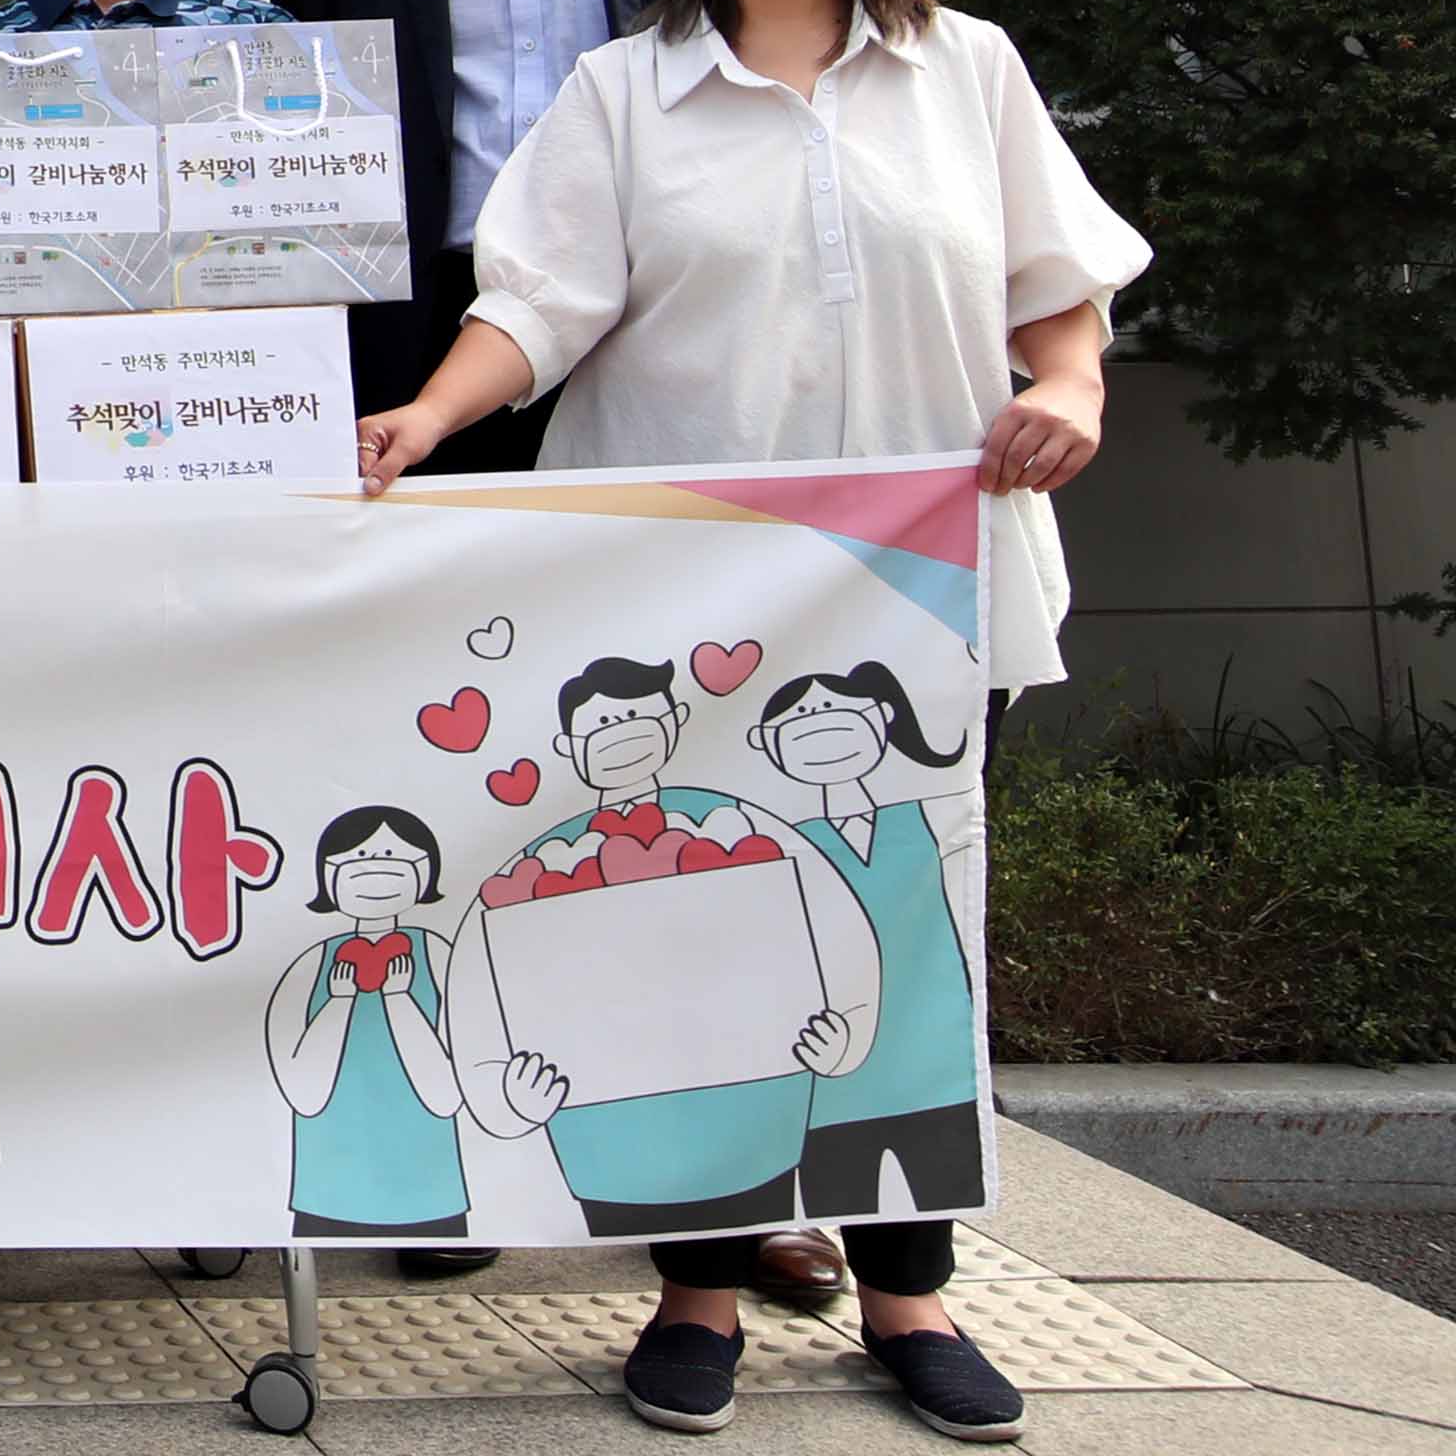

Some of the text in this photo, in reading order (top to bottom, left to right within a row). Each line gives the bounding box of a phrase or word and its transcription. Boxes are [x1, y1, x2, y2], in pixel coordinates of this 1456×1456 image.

[28, 162, 147, 186] 갈비나눔행사
[177, 151, 388, 182] 추석맞이 갈비나눔행사
[28, 211, 98, 225] 한국기초소재
[231, 204, 253, 219] 후원
[270, 201, 340, 217] 한국기초소재
[121, 349, 256, 373] 만석동 주민자치회
[67, 393, 321, 433] 추석맞이 갈비나눔행사
[123, 464, 154, 482] 후원
